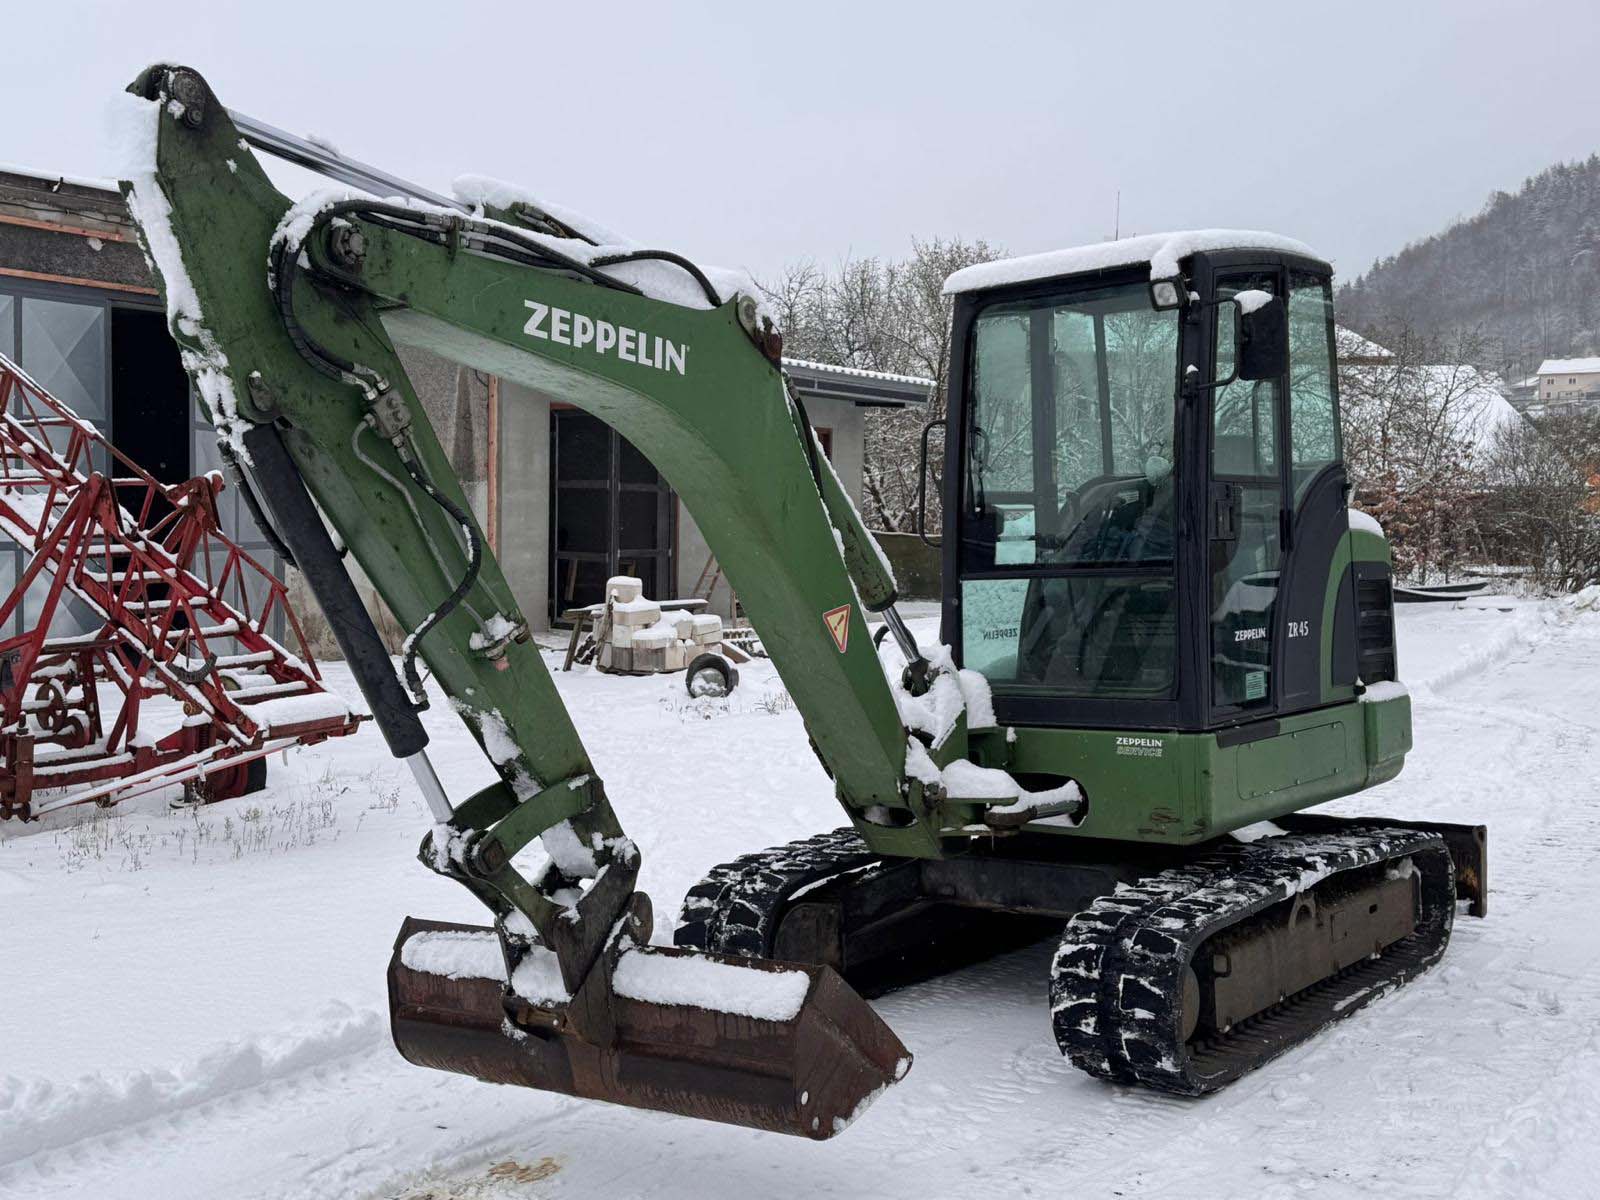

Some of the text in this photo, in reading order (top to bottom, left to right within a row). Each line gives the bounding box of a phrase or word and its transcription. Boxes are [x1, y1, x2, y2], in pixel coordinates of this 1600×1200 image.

[523, 299, 686, 376] ZEPPELIN
[1234, 627, 1266, 642] ZEPPELIN
[1288, 621, 1309, 637] ZR 45
[1115, 736, 1163, 747] ZEPPELIN
[1116, 746, 1163, 757] SERVICE
